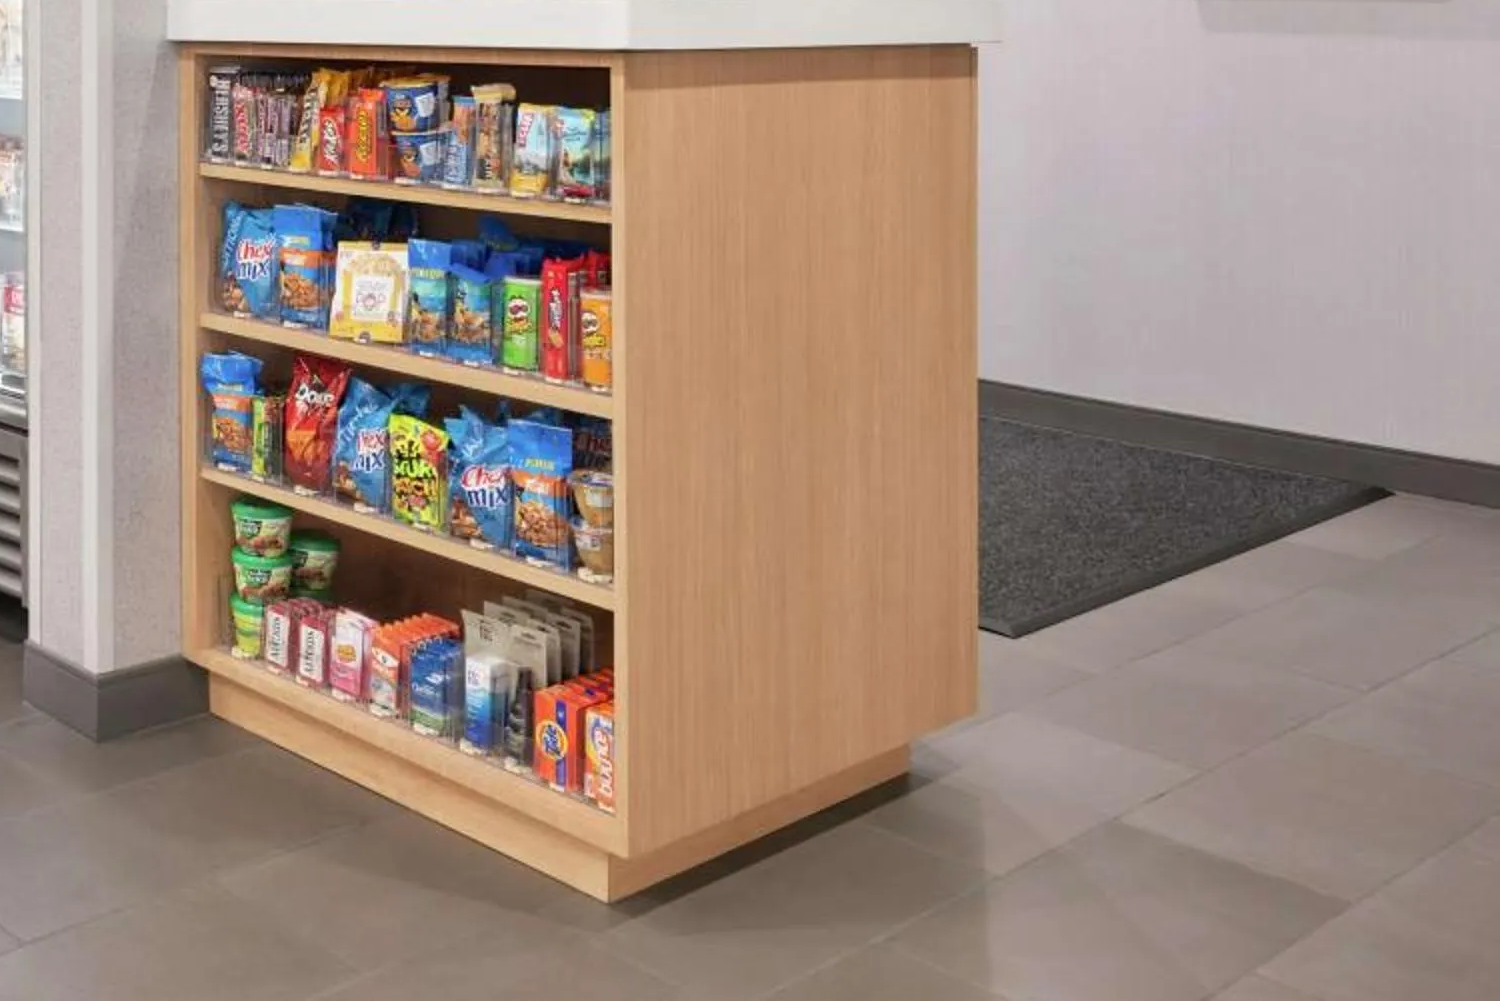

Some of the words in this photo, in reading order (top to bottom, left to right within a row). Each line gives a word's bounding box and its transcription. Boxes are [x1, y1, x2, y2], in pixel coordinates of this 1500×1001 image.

[235, 235, 276, 264] Chex
[235, 260, 271, 283] mix
[461, 463, 514, 490] Chex
[464, 487, 510, 511] mix
